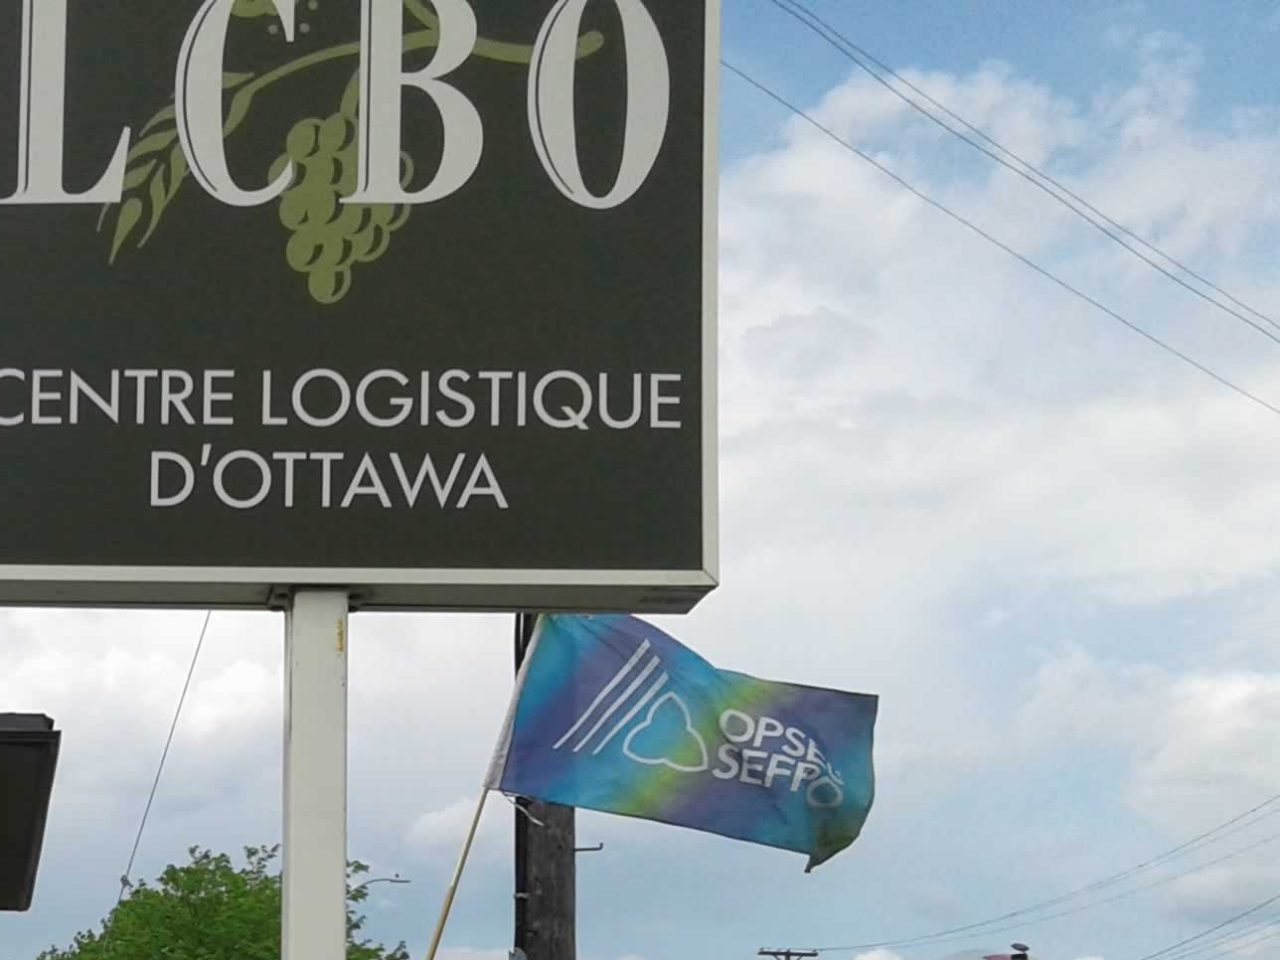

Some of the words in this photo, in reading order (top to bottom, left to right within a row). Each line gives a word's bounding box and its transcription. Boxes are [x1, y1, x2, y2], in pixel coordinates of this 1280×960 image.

[261, 368, 683, 431] LOGISTIQUE
[149, 443, 509, 510] D'OTTAWA
[711, 746, 844, 811] SEFPO
